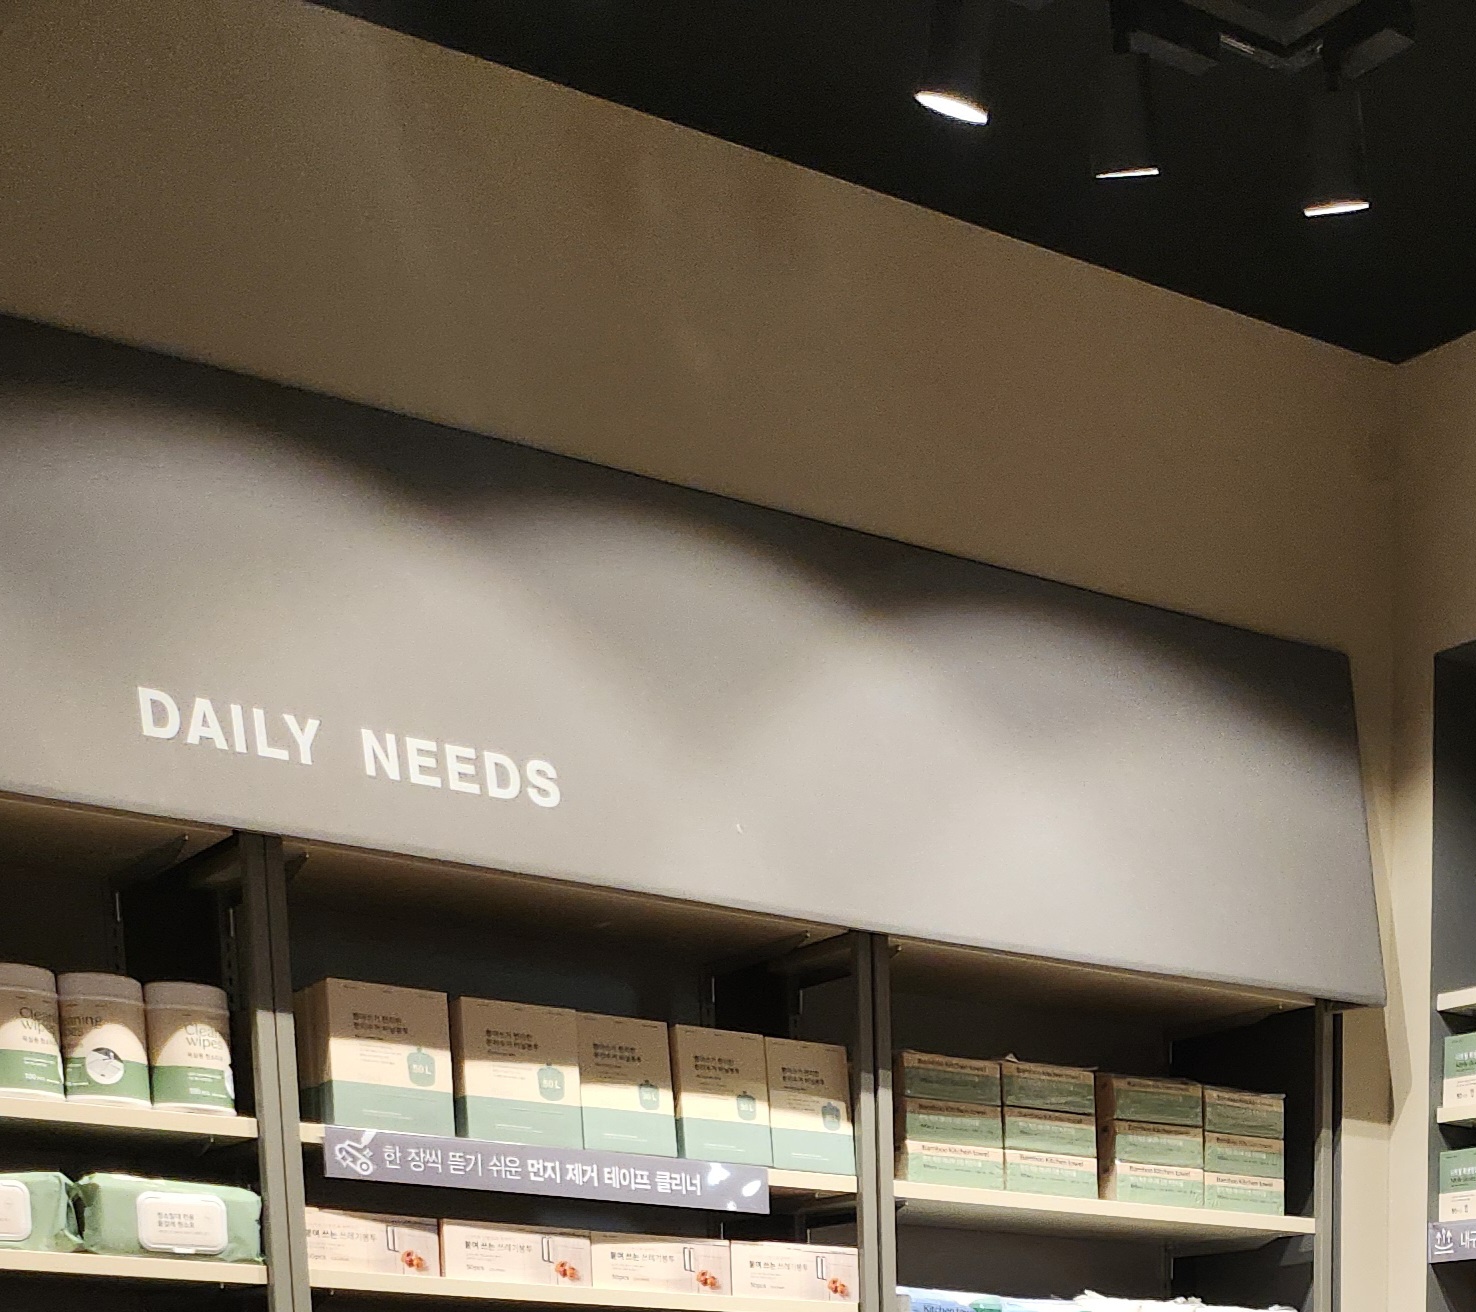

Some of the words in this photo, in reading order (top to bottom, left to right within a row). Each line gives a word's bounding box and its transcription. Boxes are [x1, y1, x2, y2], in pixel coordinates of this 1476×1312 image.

[136, 686, 321, 766] DAILY
[360, 727, 561, 808] NEEDS
[384, 1146, 401, 1169] 한
[407, 1149, 442, 1173] 장씩
[449, 1152, 482, 1176] 뜯기
[489, 1155, 521, 1180] 쉬운
[527, 1159, 561, 1184] 먼지
[566, 1164, 599, 1187] 제거
[604, 1166, 650, 1190] 테이프
[655, 1170, 701, 1195] 클리너
